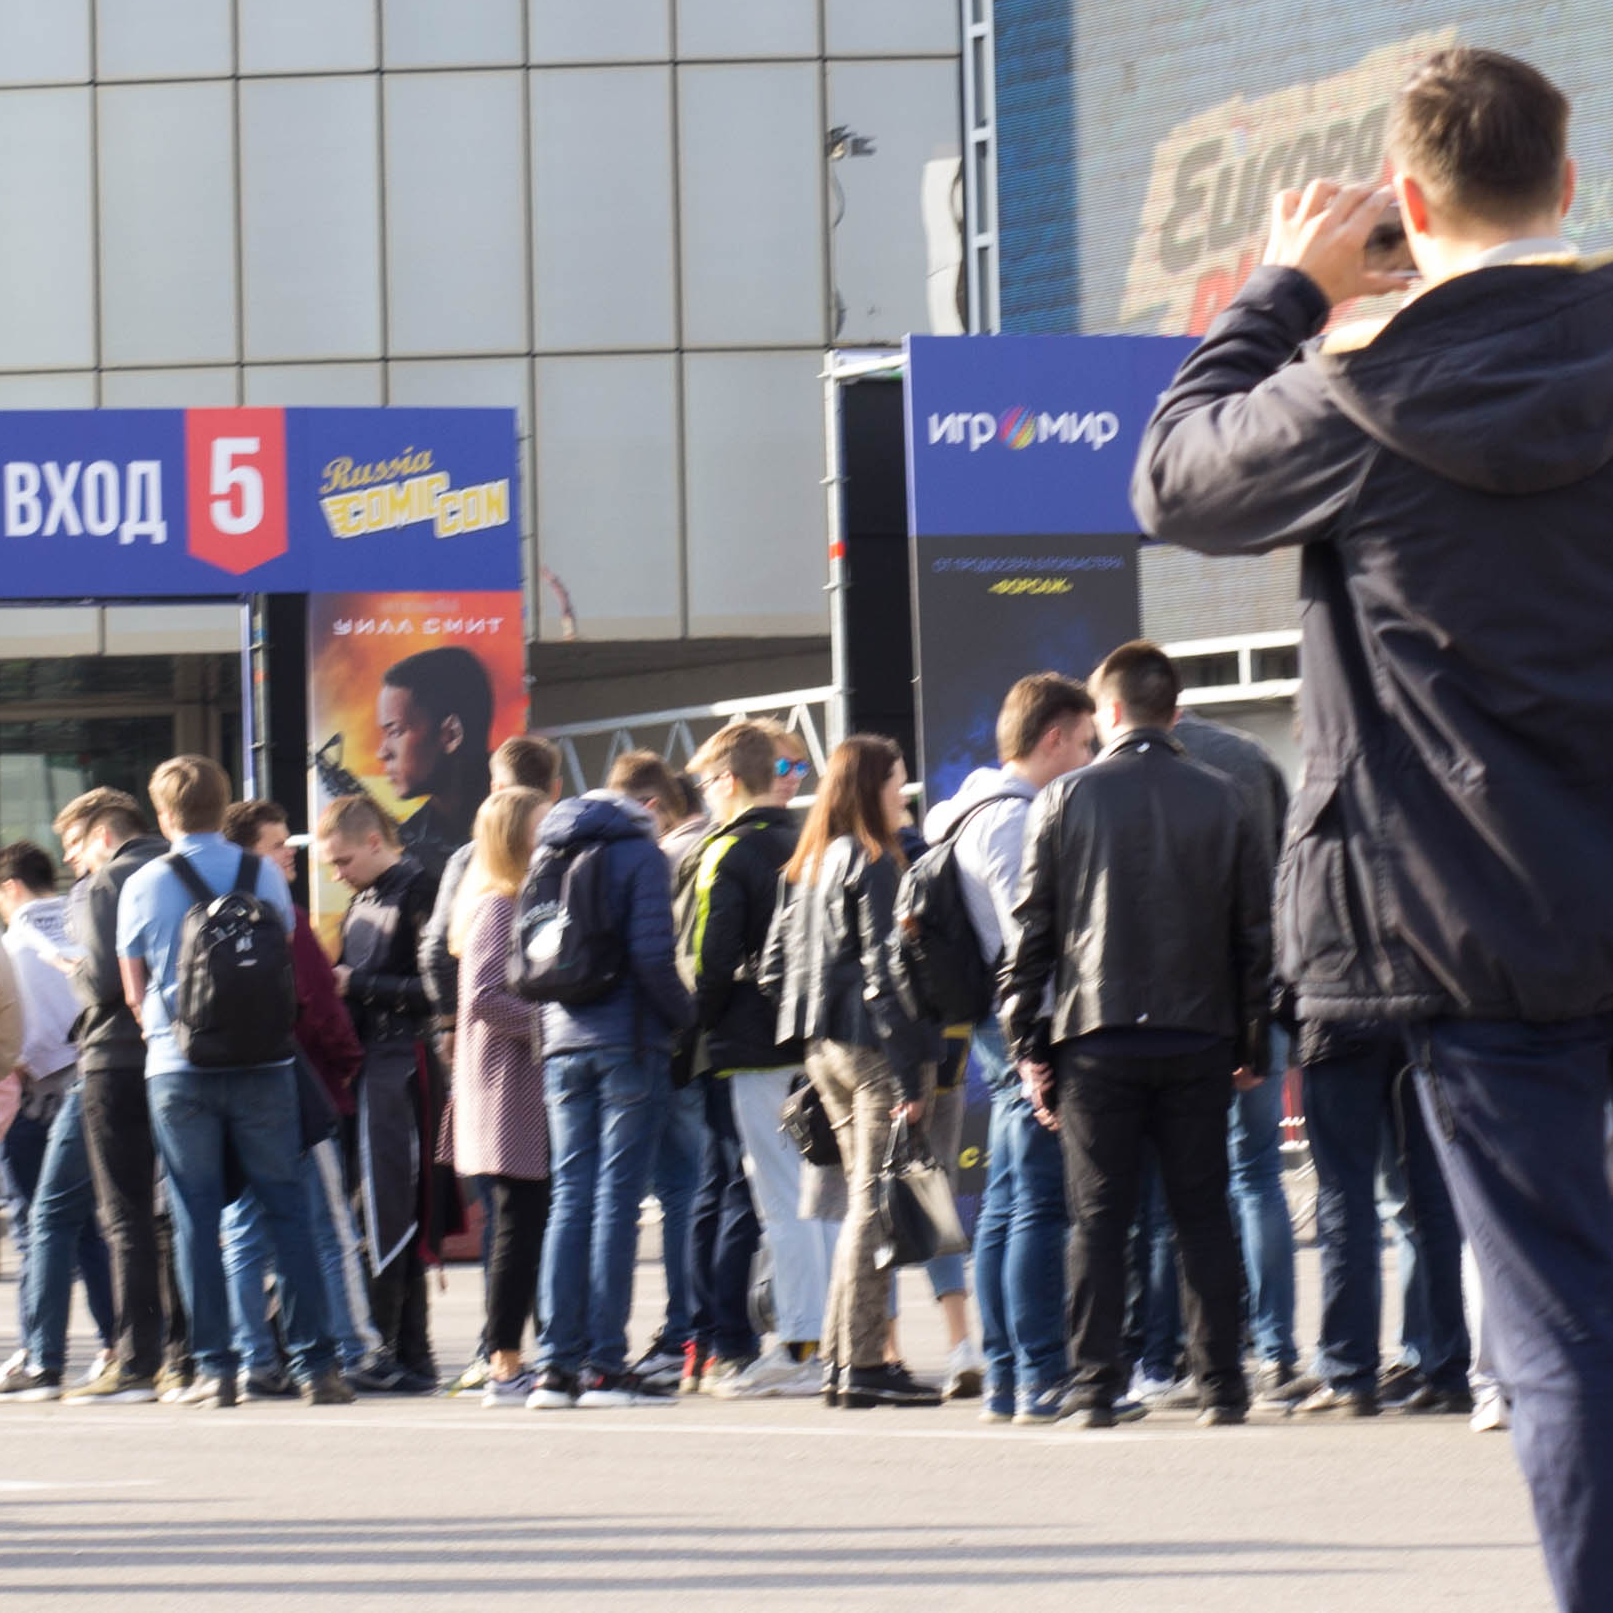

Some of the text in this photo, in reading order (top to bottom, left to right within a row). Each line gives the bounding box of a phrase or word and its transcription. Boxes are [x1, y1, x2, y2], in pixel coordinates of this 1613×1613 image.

[3, 437, 265, 546] ВХОД 5
[319, 445, 435, 494] Russia
[320, 470, 510, 539] COMIC CON
[332, 616, 505, 636] УИЛЛ СМИТ
